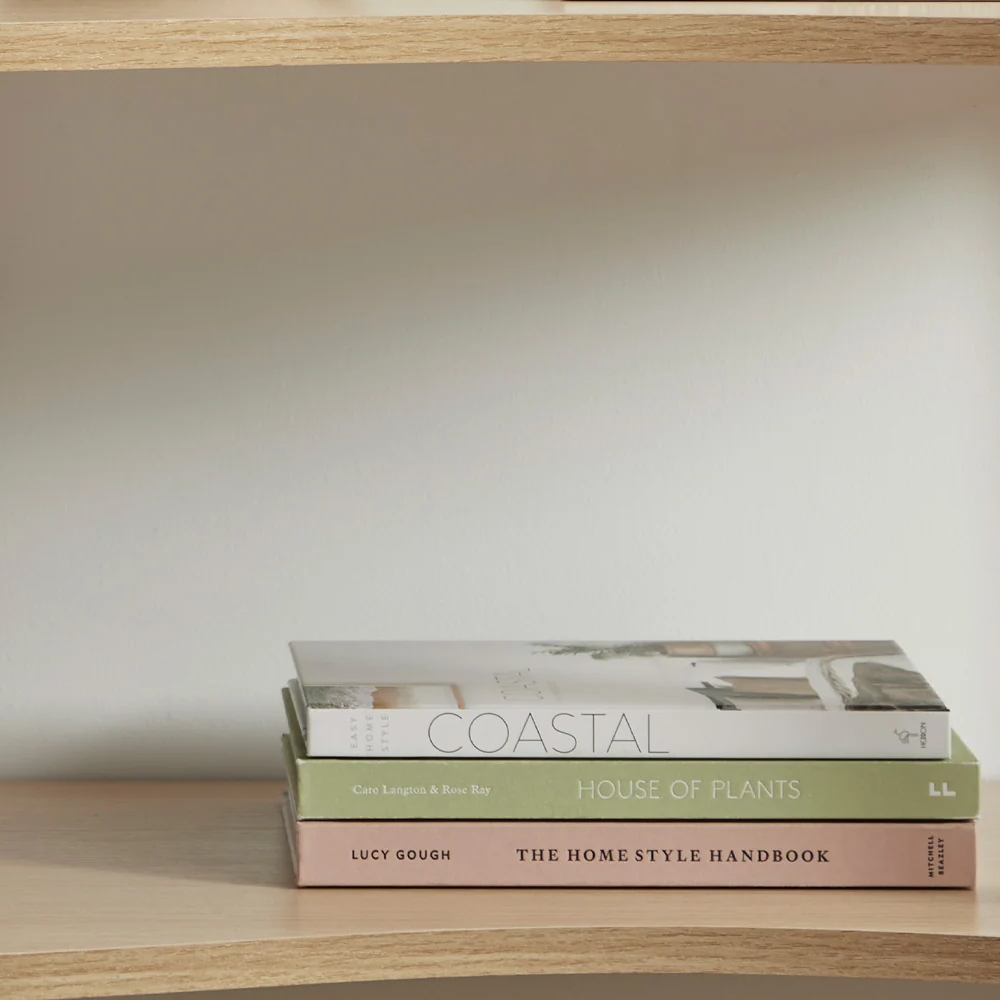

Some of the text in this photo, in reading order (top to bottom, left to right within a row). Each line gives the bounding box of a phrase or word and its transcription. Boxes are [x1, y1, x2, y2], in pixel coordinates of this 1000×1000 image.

[350, 717, 359, 749] EASY
[366, 716, 375, 751] HOME
[381, 716, 389, 752] STYLE
[428, 713, 669, 754] COASTAL
[353, 785, 492, 796] Caro Langton & Rose Ray
[578, 780, 803, 799] HOUSE OF PLANTS
[352, 850, 450, 860] LUCY GOUGH
[517, 849, 829, 862] THE HOME STYLE HANDBOOK
[937, 837, 945, 876] BEAZLEY
